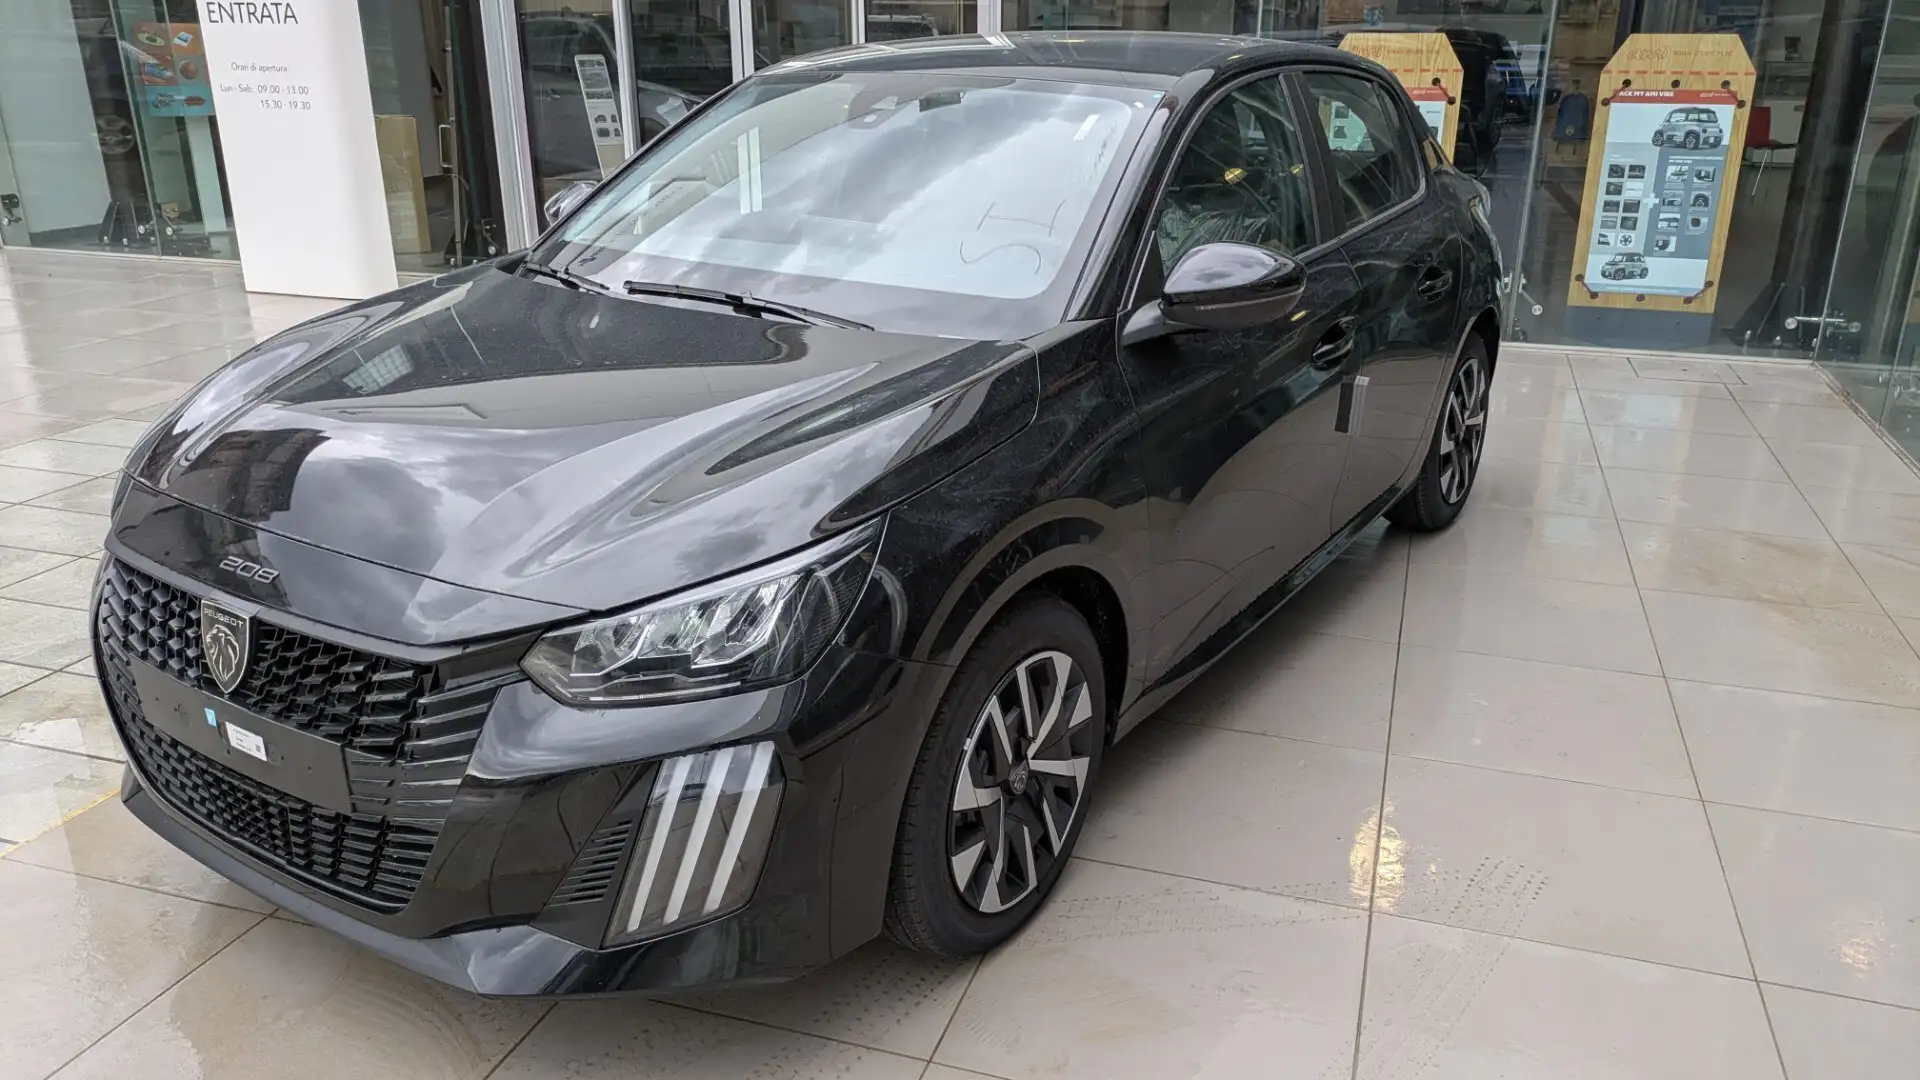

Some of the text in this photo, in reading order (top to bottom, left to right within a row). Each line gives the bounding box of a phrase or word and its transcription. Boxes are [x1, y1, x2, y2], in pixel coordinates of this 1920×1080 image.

[206, 2, 299, 25] ENTRATA
[231, 61, 288, 74] Orari di apertura
[219, 83, 234, 92] Lun
[219, 556, 280, 584] 208
[203, 607, 244, 628] PEUGEOT
